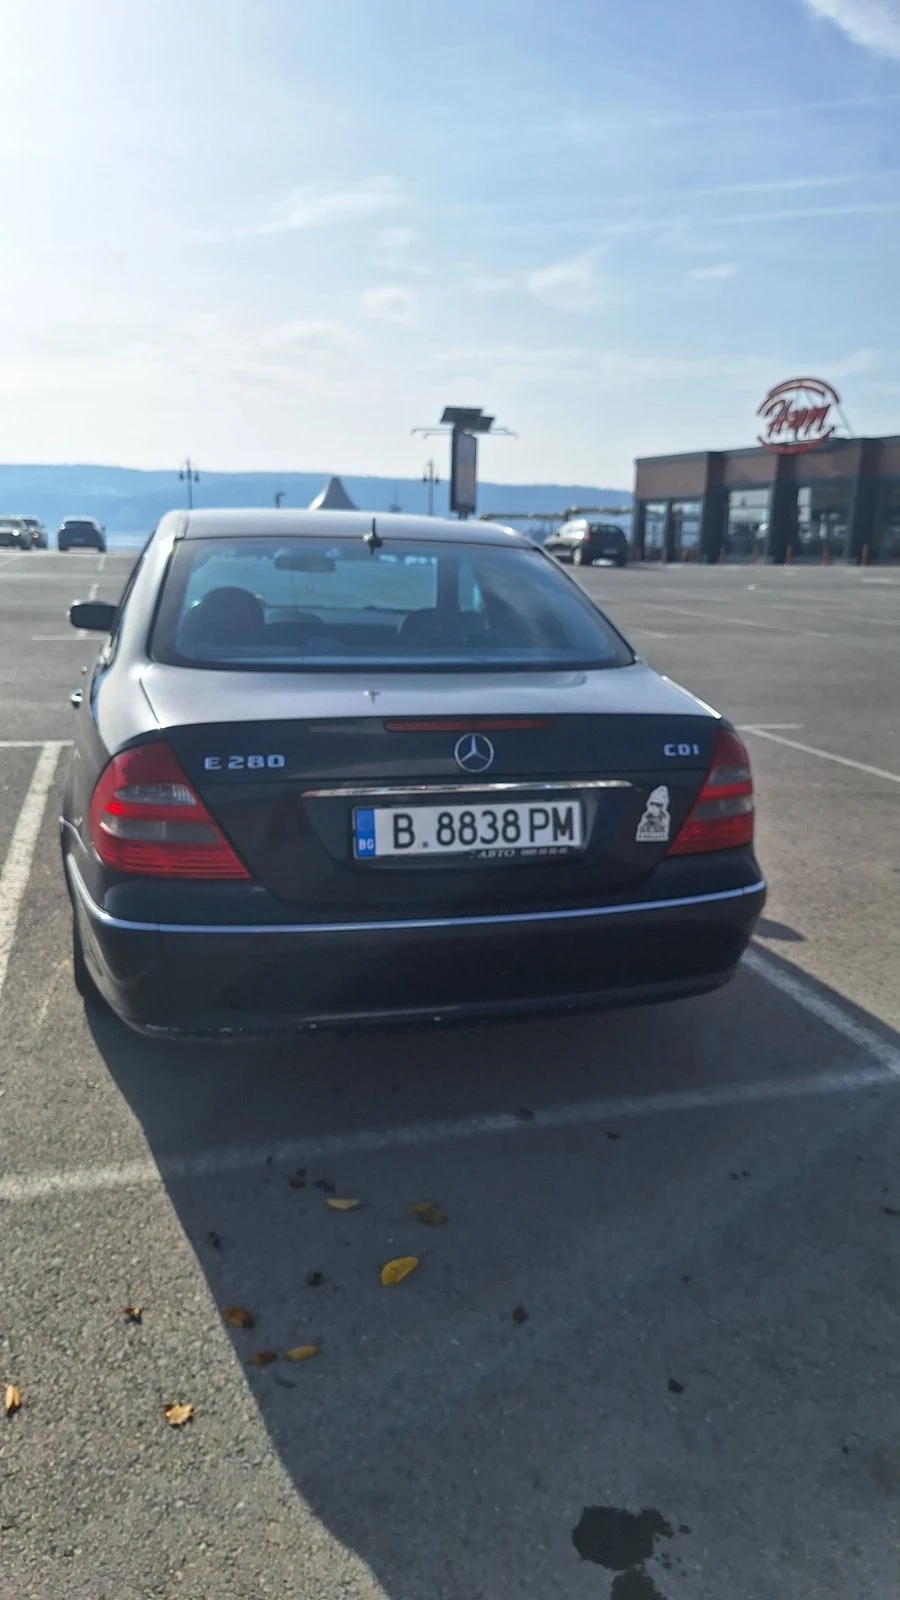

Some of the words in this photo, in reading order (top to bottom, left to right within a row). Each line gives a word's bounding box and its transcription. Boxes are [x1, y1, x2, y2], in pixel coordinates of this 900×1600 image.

[663, 743, 700, 757] CDI
[204, 756, 221, 770] E
[228, 754, 285, 769] 280
[358, 838, 374, 850] BG
